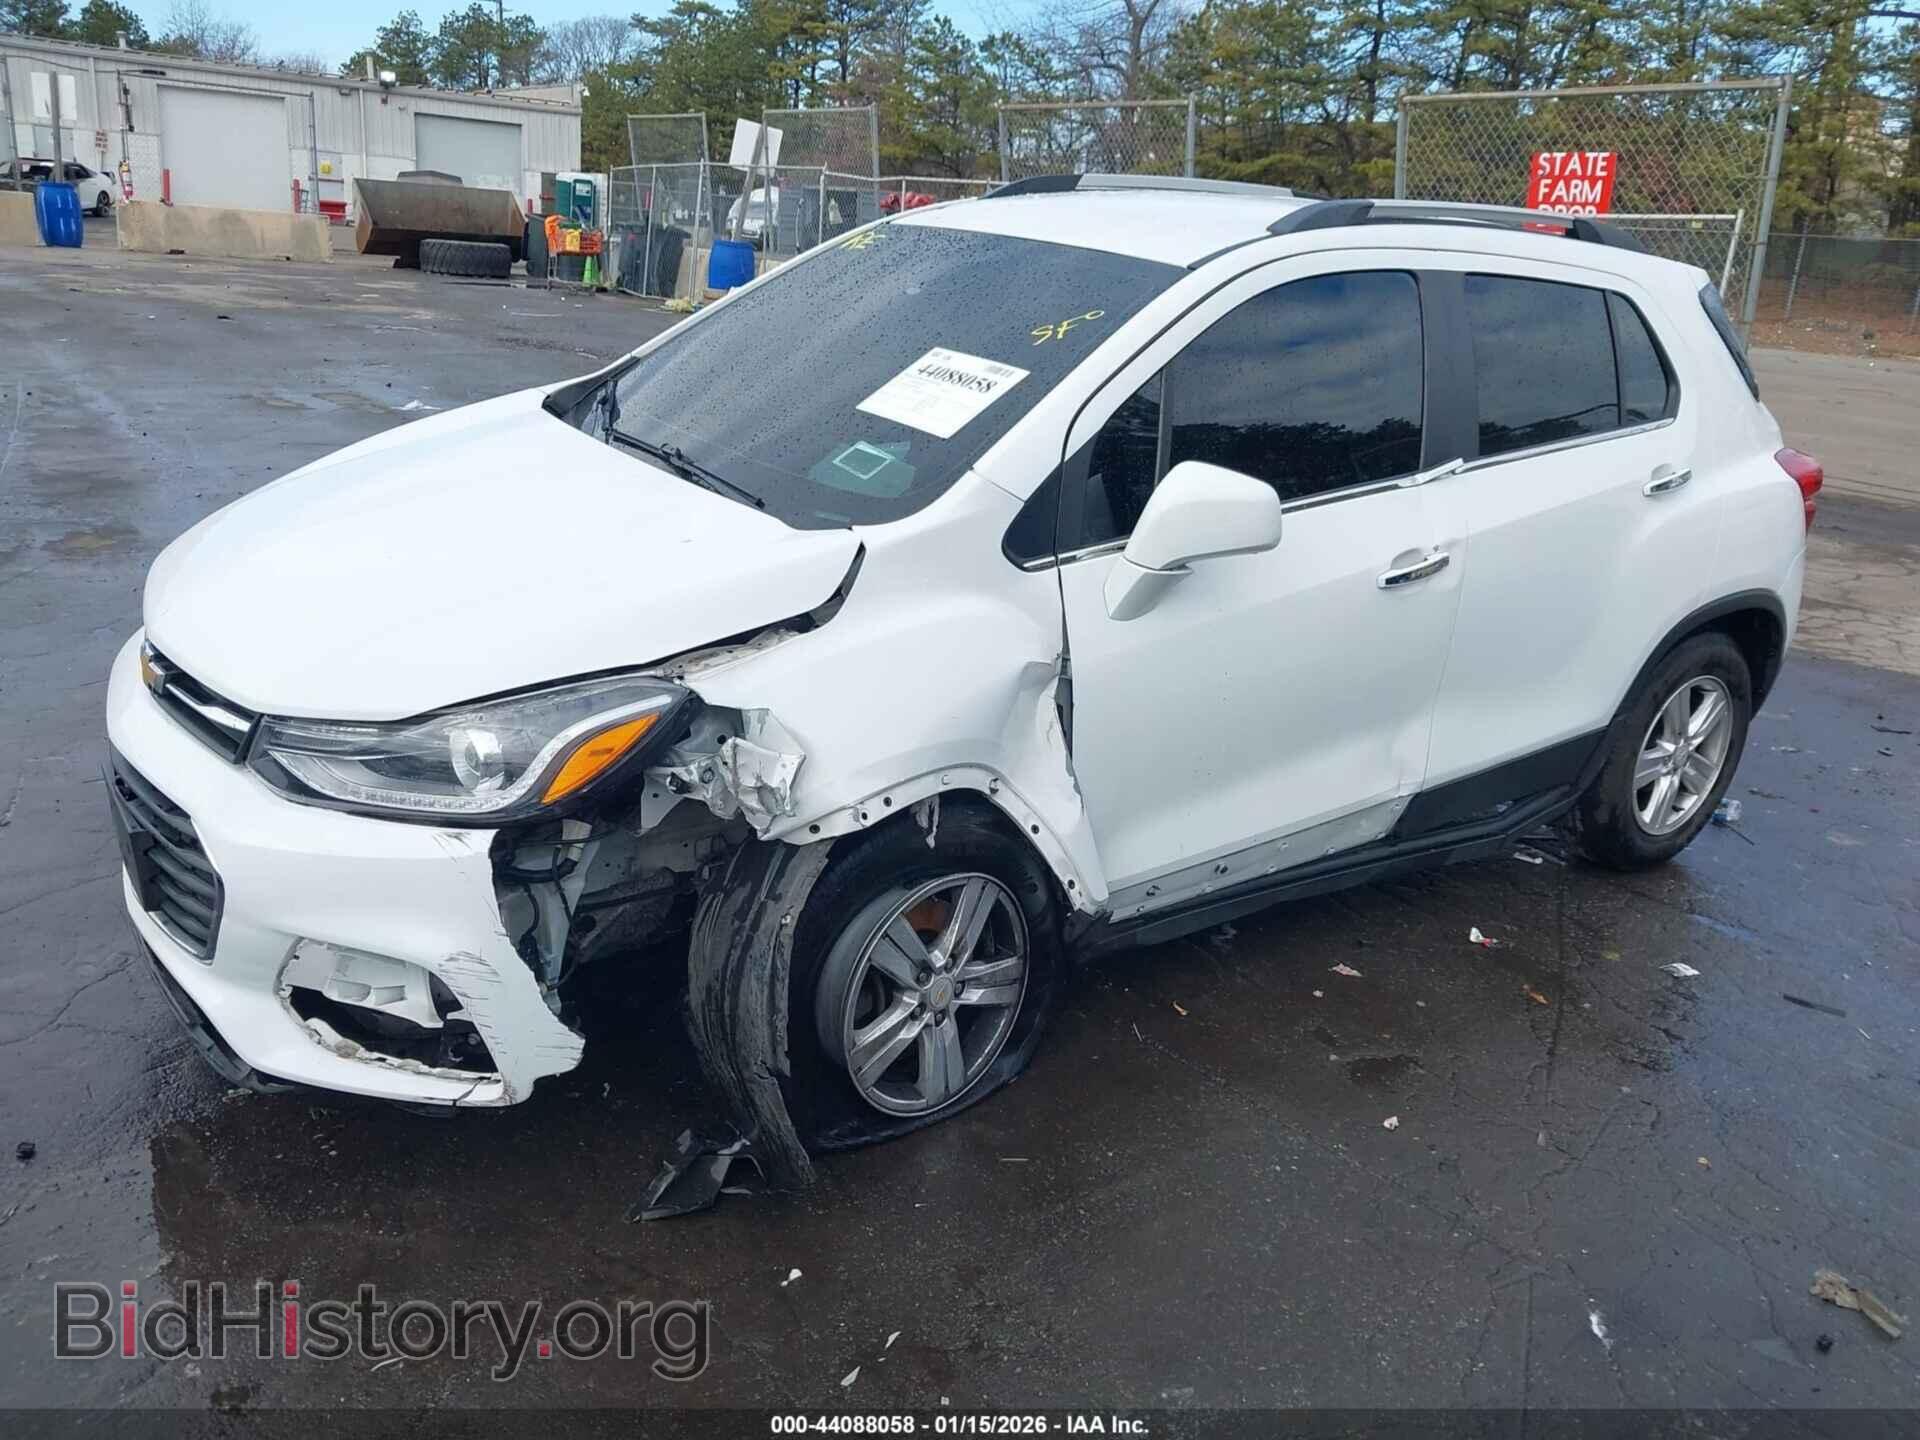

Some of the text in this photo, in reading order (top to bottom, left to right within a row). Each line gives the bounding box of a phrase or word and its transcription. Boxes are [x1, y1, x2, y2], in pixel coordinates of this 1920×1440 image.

[1537, 152, 1610, 176] STATE
[1538, 179, 1603, 203] FARM
[917, 363, 998, 393] 44088058
